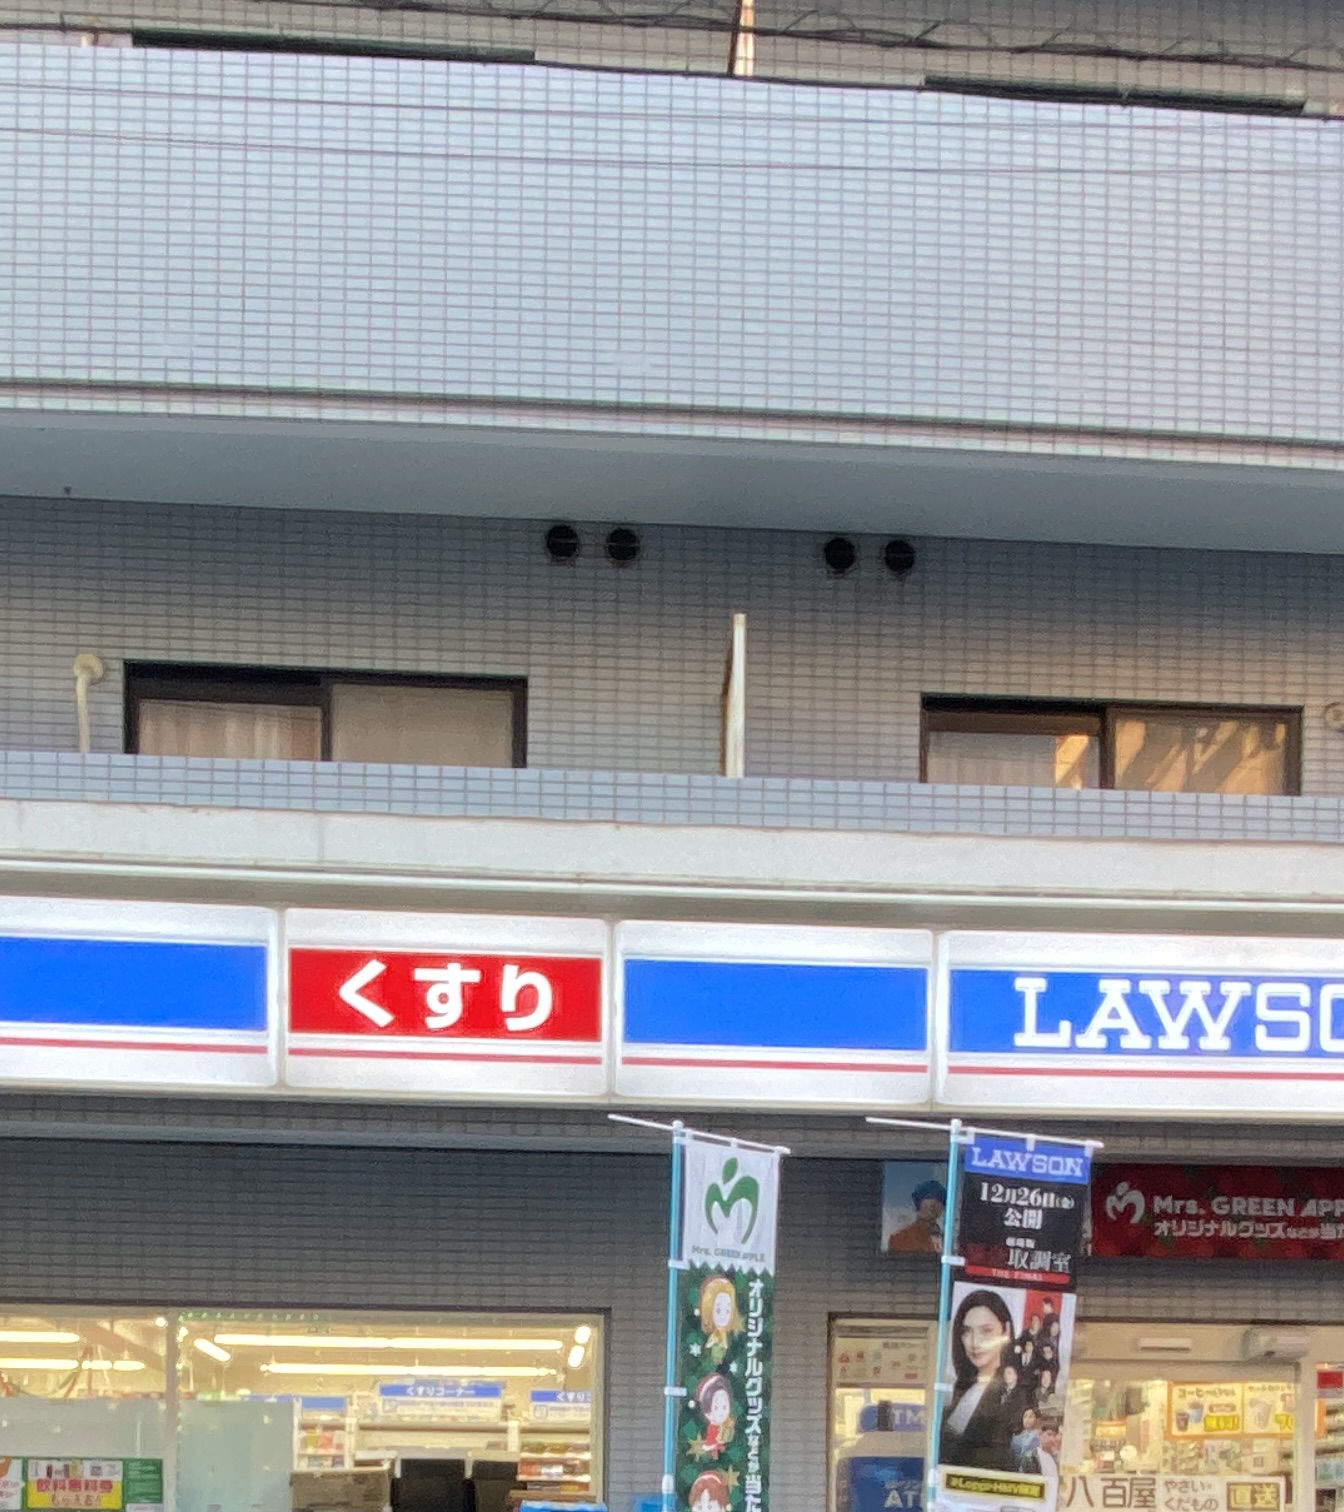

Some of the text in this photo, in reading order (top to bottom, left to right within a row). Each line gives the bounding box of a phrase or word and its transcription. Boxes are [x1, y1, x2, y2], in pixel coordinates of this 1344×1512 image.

[338, 958, 554, 1032] くすり
[971, 1146, 1084, 1177] LAWSON
[1153, 1195, 1205, 1215] Mrs.
[1211, 1196, 1296, 1217] GREEN
[1003, 1207, 1043, 1230] 公開
[406, 1385, 476, 1397] くすりコーナー
[1066, 1475, 1156, 1509] 八百屋
[1164, 1497, 1219, 1512] くだもの
